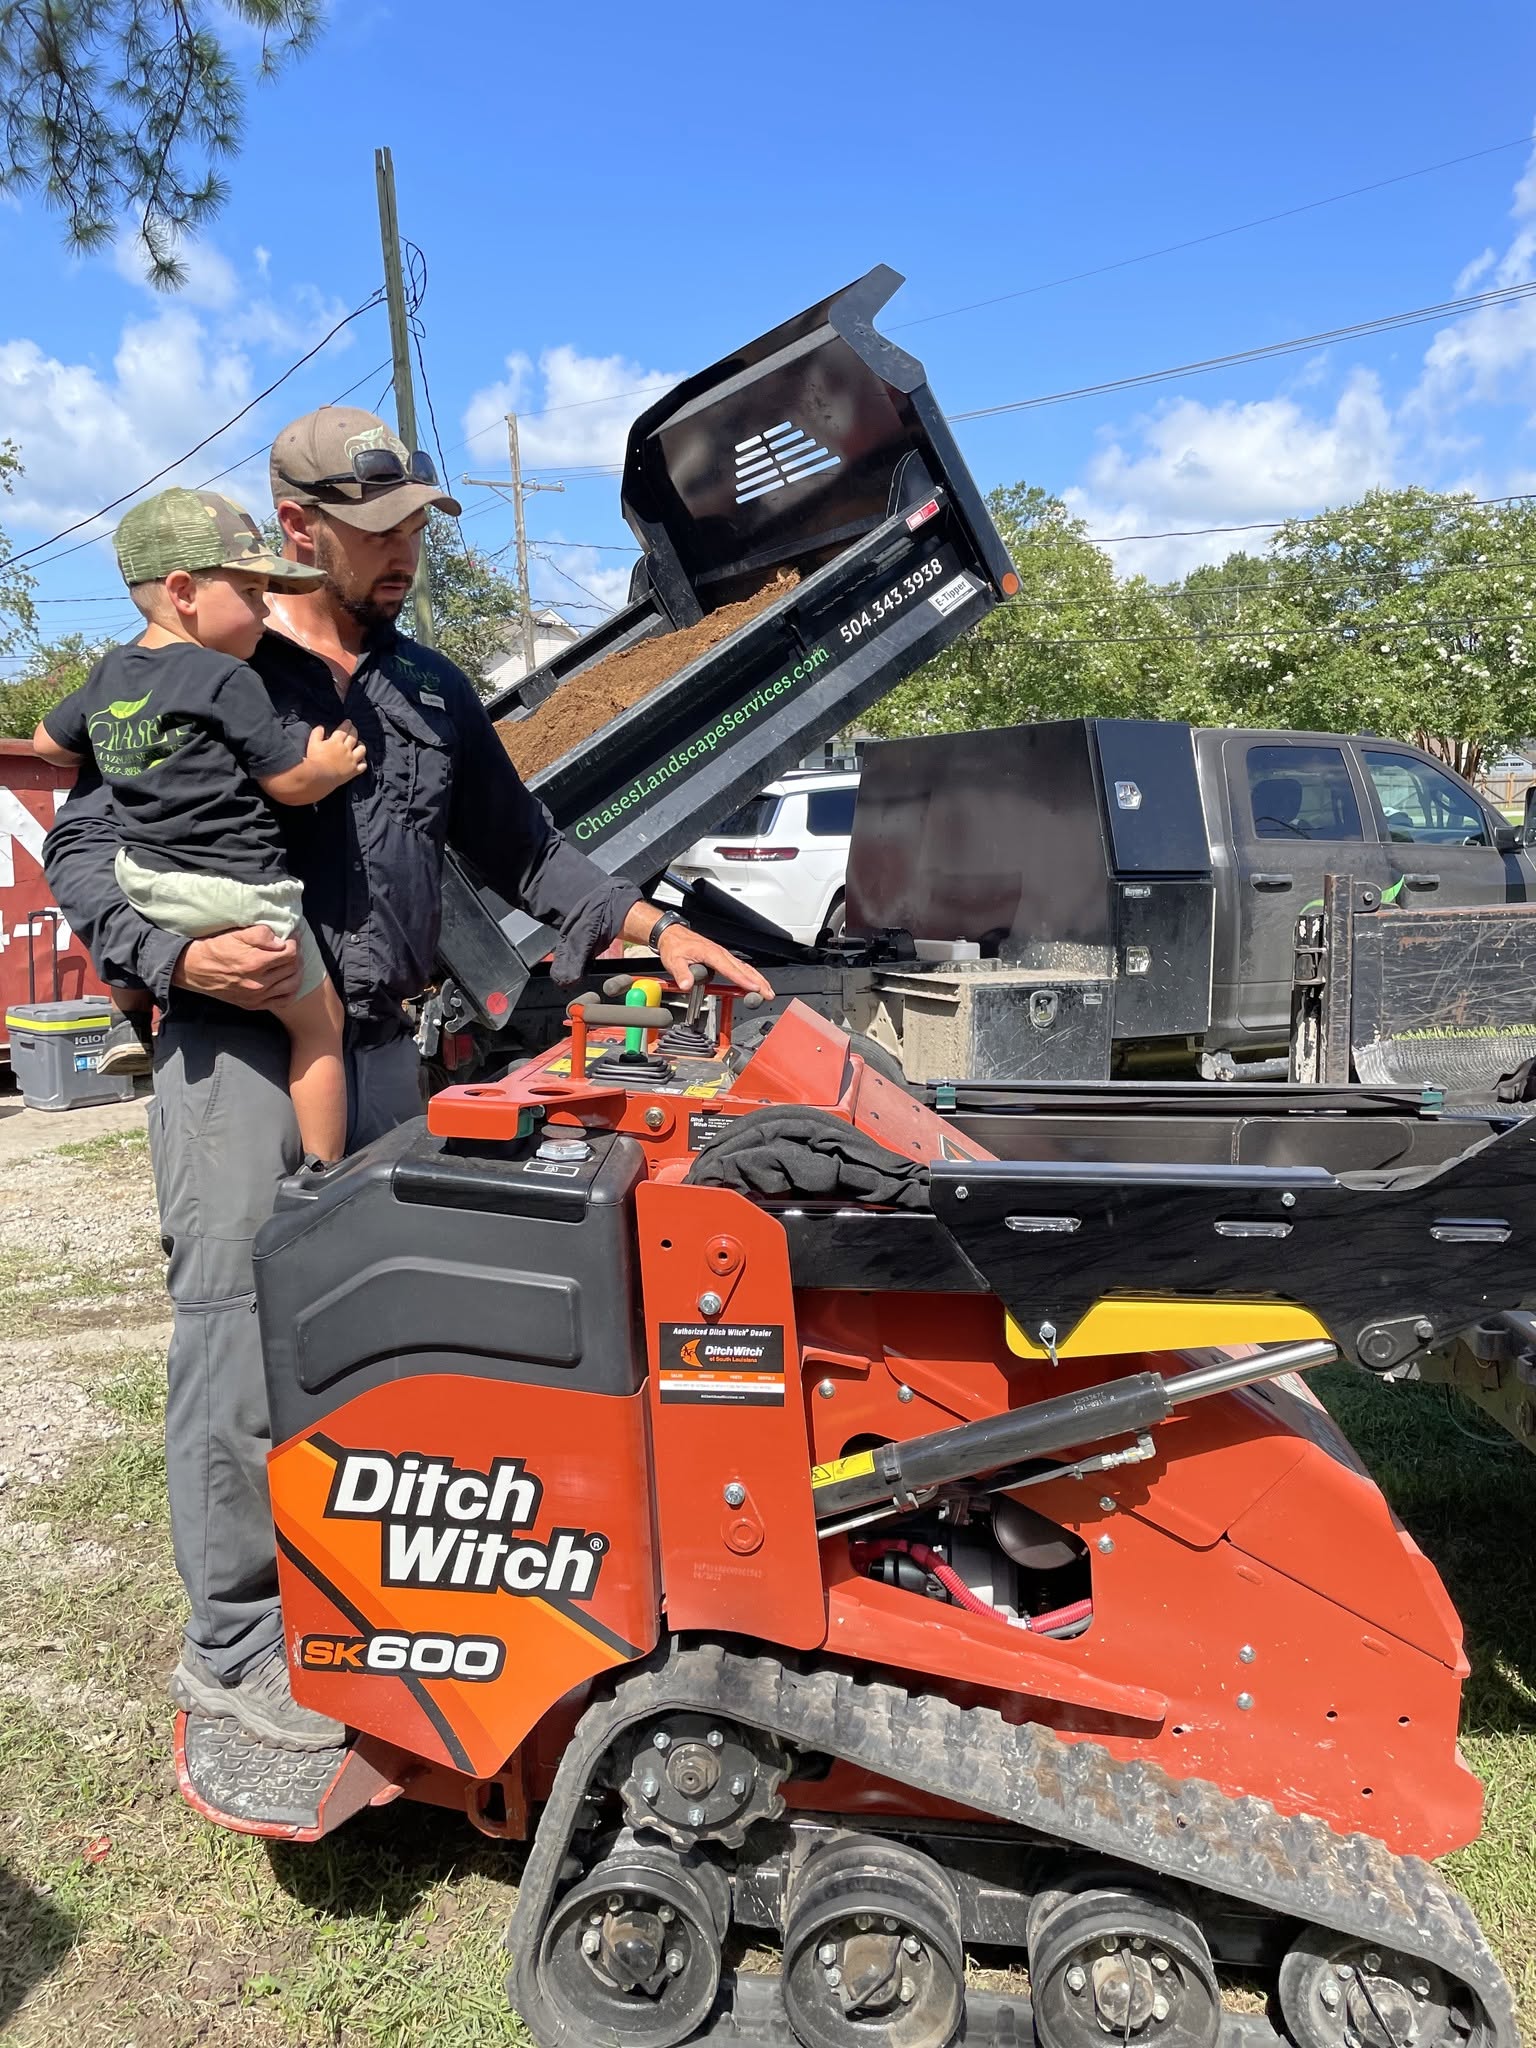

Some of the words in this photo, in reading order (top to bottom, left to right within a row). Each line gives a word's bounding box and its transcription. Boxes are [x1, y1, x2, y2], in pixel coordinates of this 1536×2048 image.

[840, 558, 943, 643] 504.343.3938
[935, 581, 967, 607] E-Tipper
[575, 647, 830, 841] ChasesLandscapeServices.com
[673, 1327, 708, 1336] Authorized
[709, 1328, 726, 1336] Ditch
[750, 1329, 772, 1337] Dealer
[333, 1456, 537, 1523] Ditch
[304, 1637, 500, 1677] SK600
